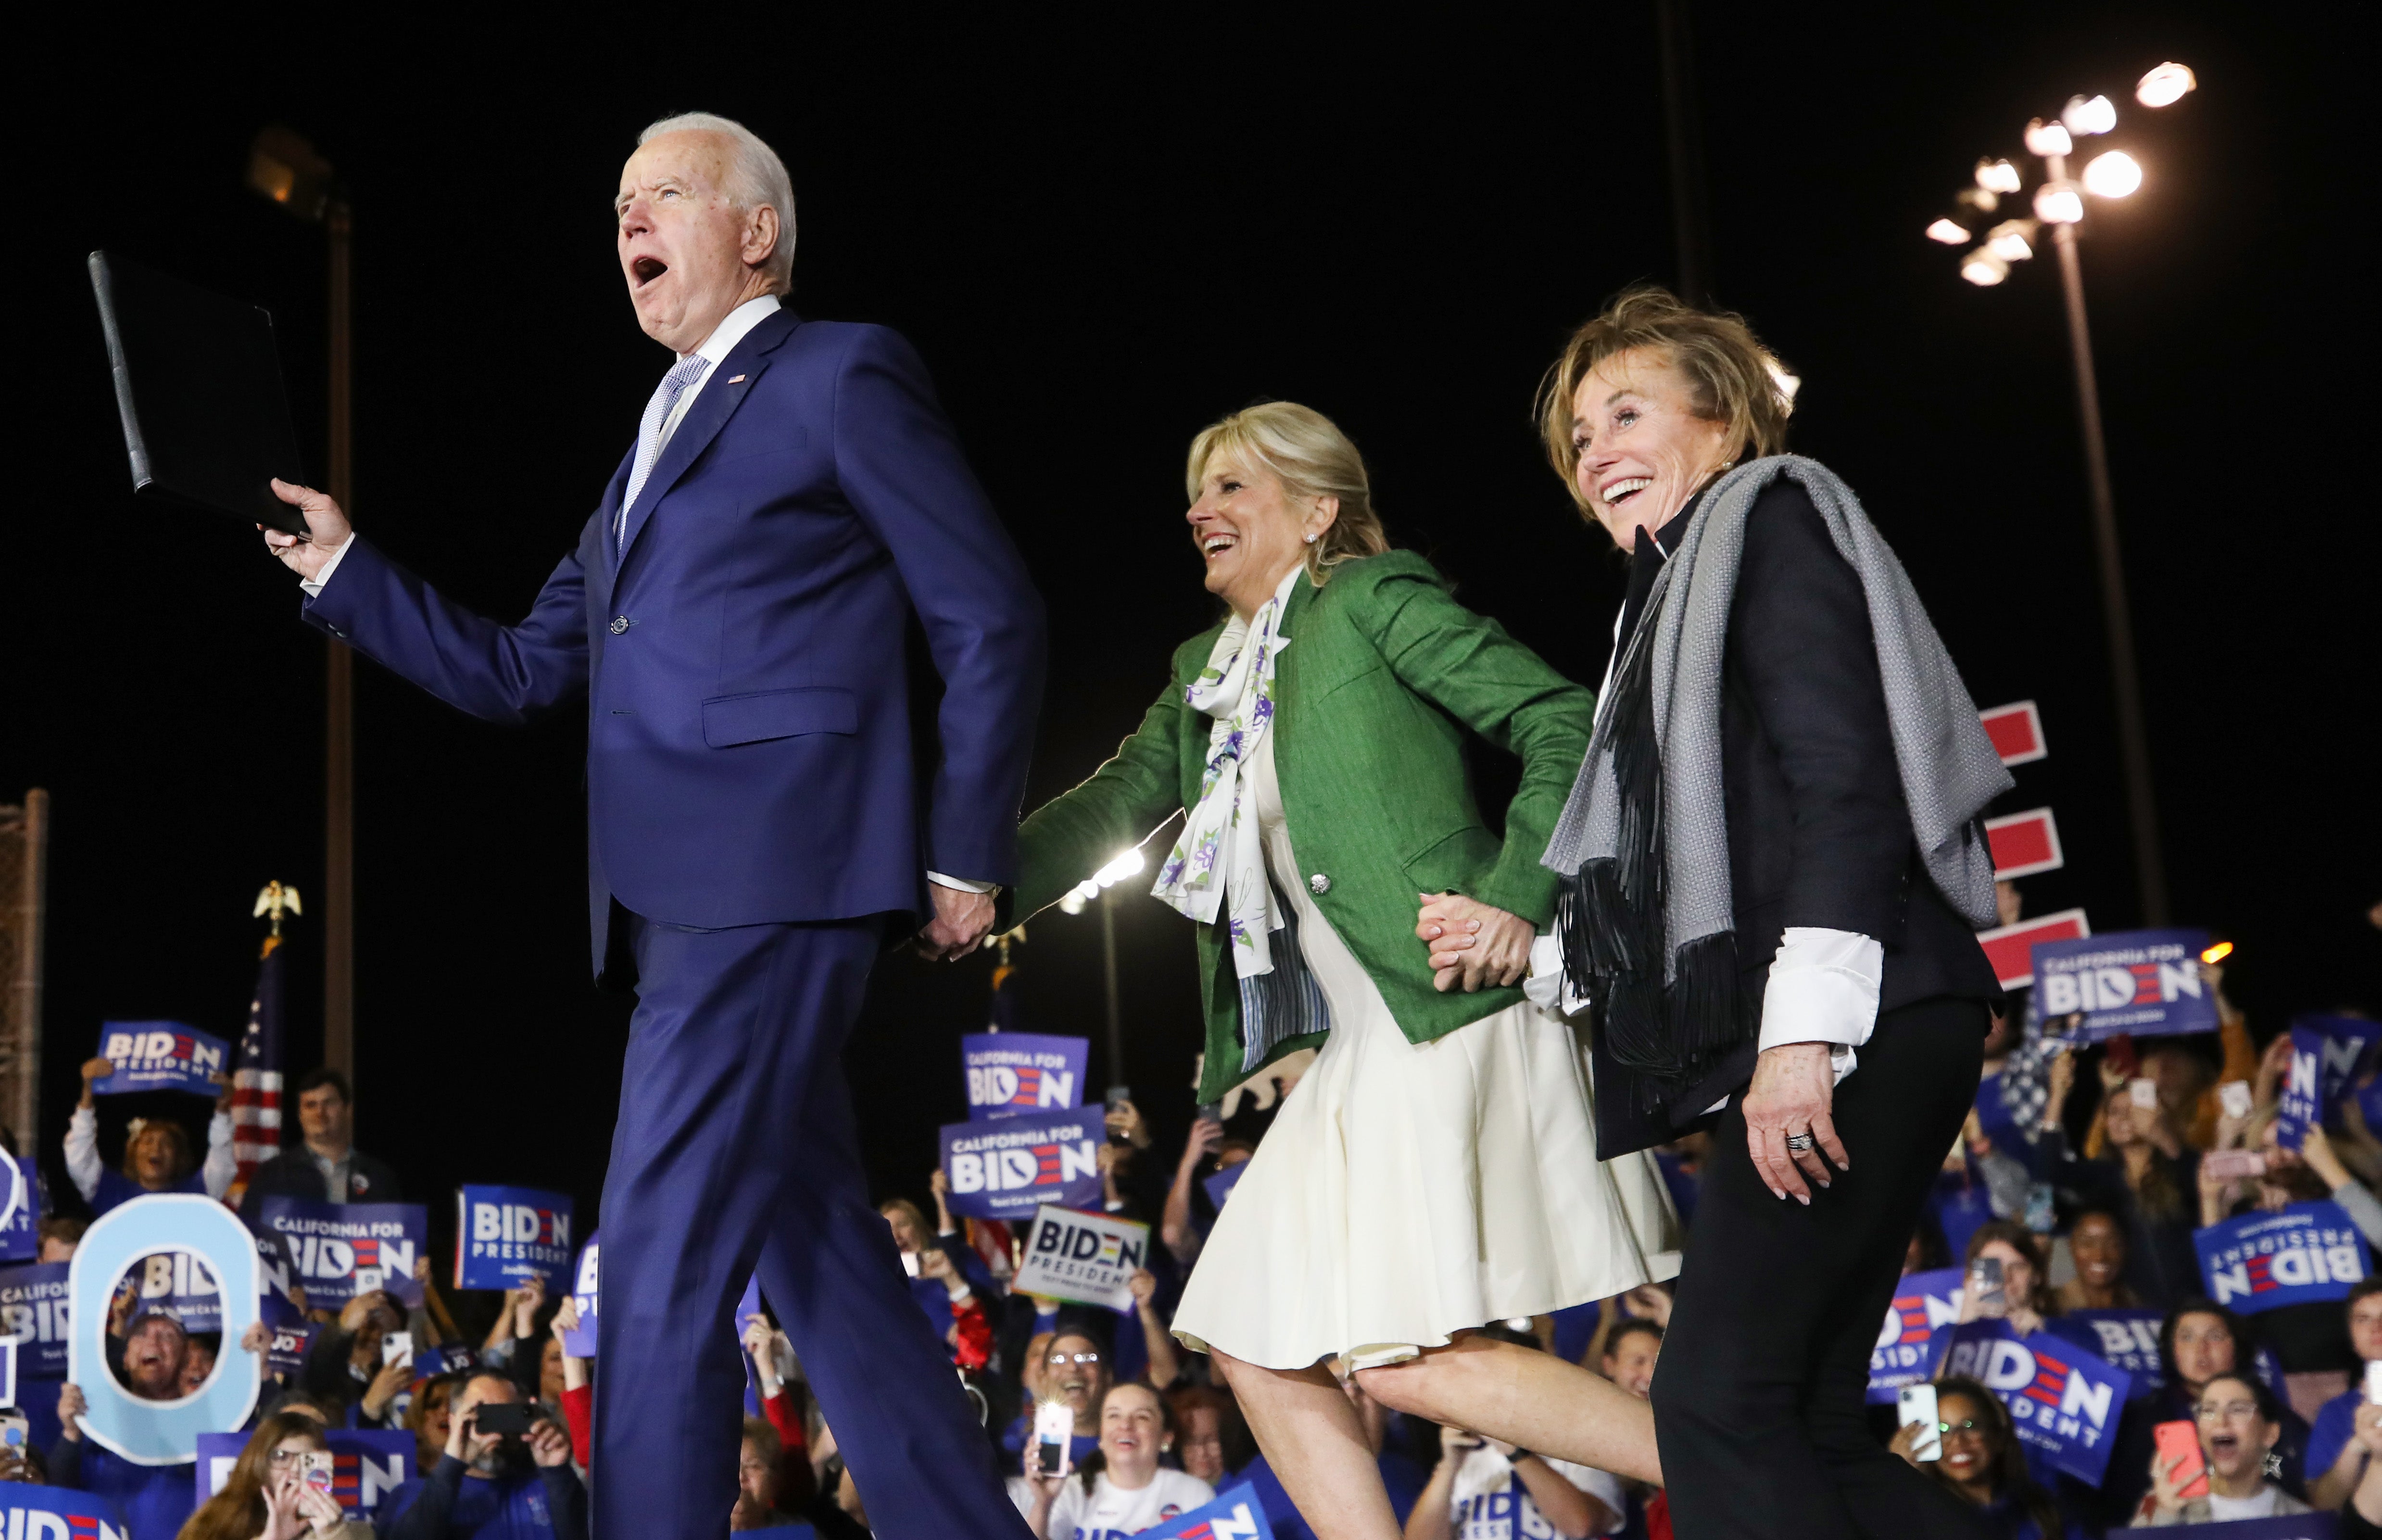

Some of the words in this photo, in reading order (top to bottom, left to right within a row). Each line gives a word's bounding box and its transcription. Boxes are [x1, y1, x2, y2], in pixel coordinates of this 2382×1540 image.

[2044, 958, 2203, 1016] BIDEN
[105, 1031, 221, 1070] BIDEN
[968, 1066, 1074, 1110] BIDEN
[951, 1130, 1049, 1153] CALIFORNIA
[1049, 1124, 1084, 1143] FOR
[951, 1140, 1097, 1194] BIDEN
[273, 1215, 369, 1237] CALIFORNIA
[370, 1221, 404, 1238] FOR
[474, 1202, 569, 1247] BIDEN
[1036, 1219, 1142, 1270] BIDEN
[472, 1241, 568, 1265] PRESIDENT
[1030, 1254, 1124, 1285] PRESIDEN
[2212, 1243, 2364, 1306] BIDEN
[1950, 1339, 2114, 1430] BIDEN
